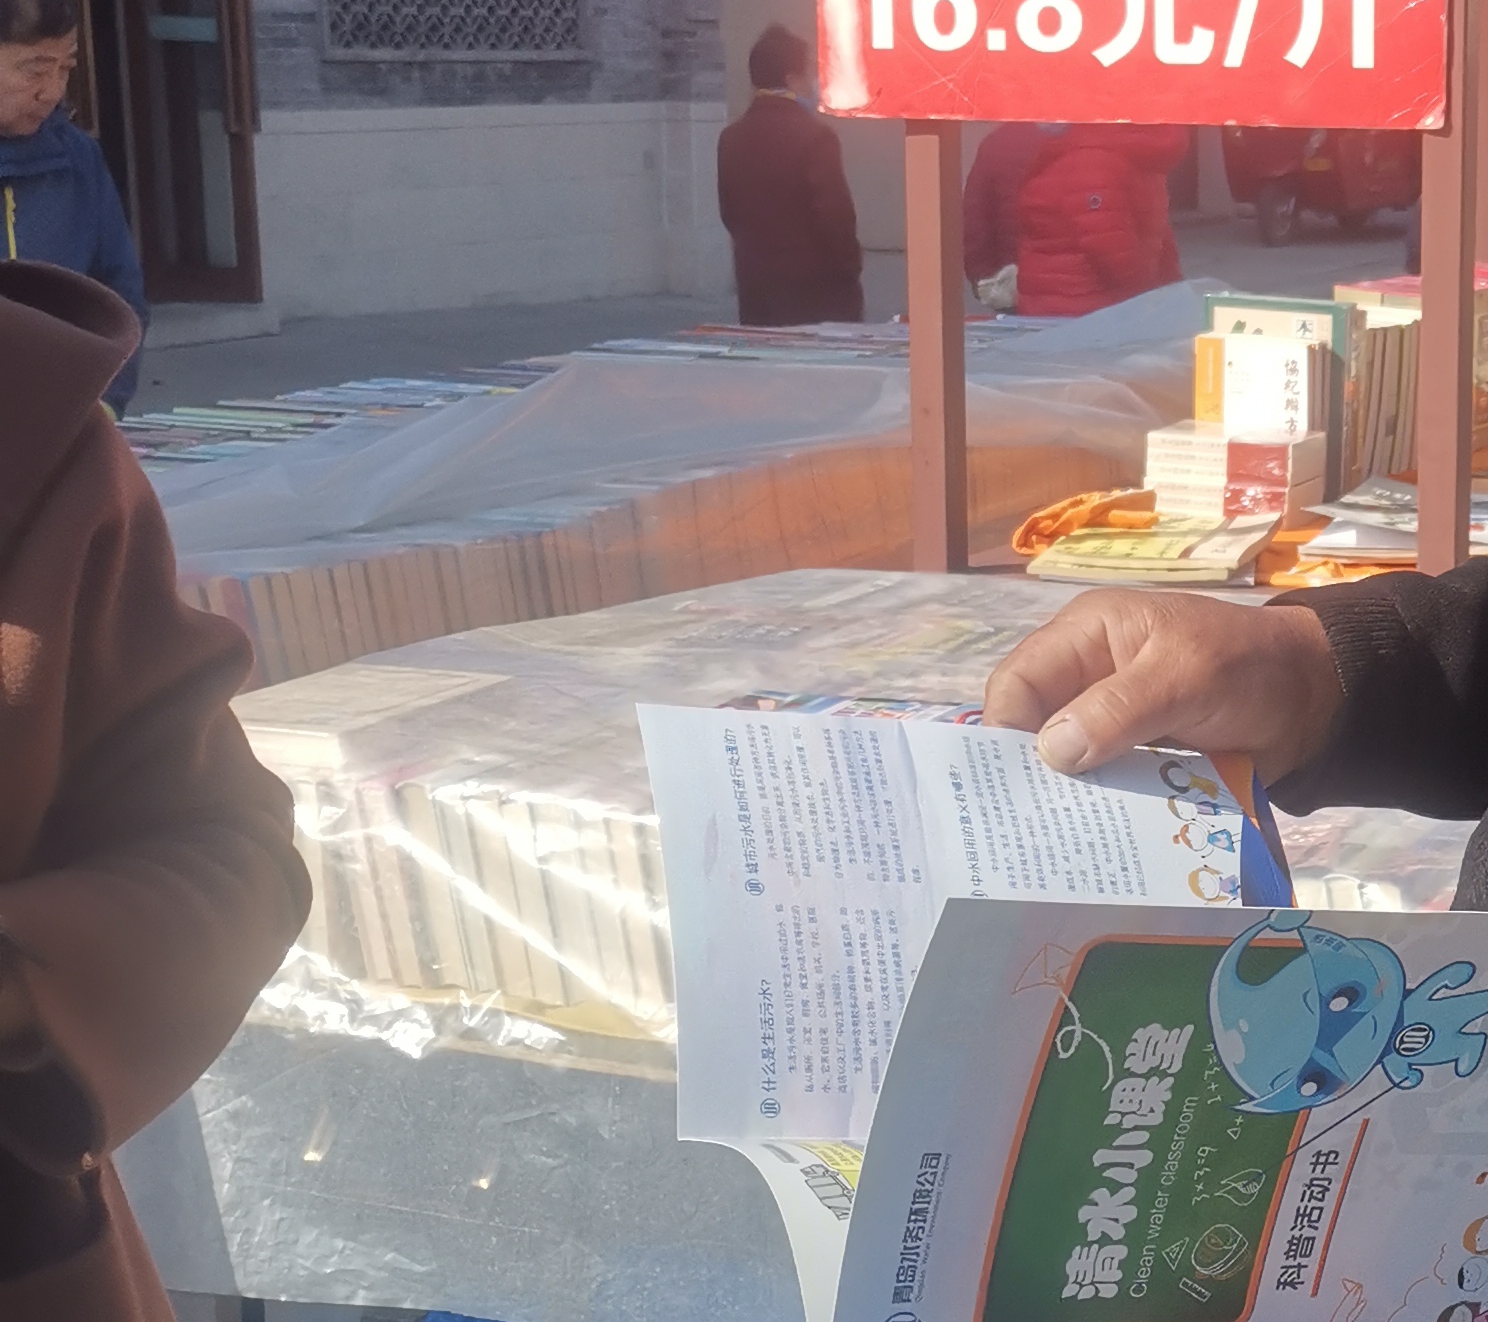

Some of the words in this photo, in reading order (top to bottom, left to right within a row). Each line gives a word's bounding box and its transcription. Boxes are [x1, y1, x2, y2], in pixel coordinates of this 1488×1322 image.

[892, 1152, 942, 1304] 青岛水务环境公司
[1060, 1024, 1194, 1301] 清水小课堂
[1130, 1245, 1156, 1297] Clean
[1144, 1191, 1172, 1238] water
[1159, 1096, 1200, 1186] classroom
[1275, 1149, 1340, 1291] 科普活动书
